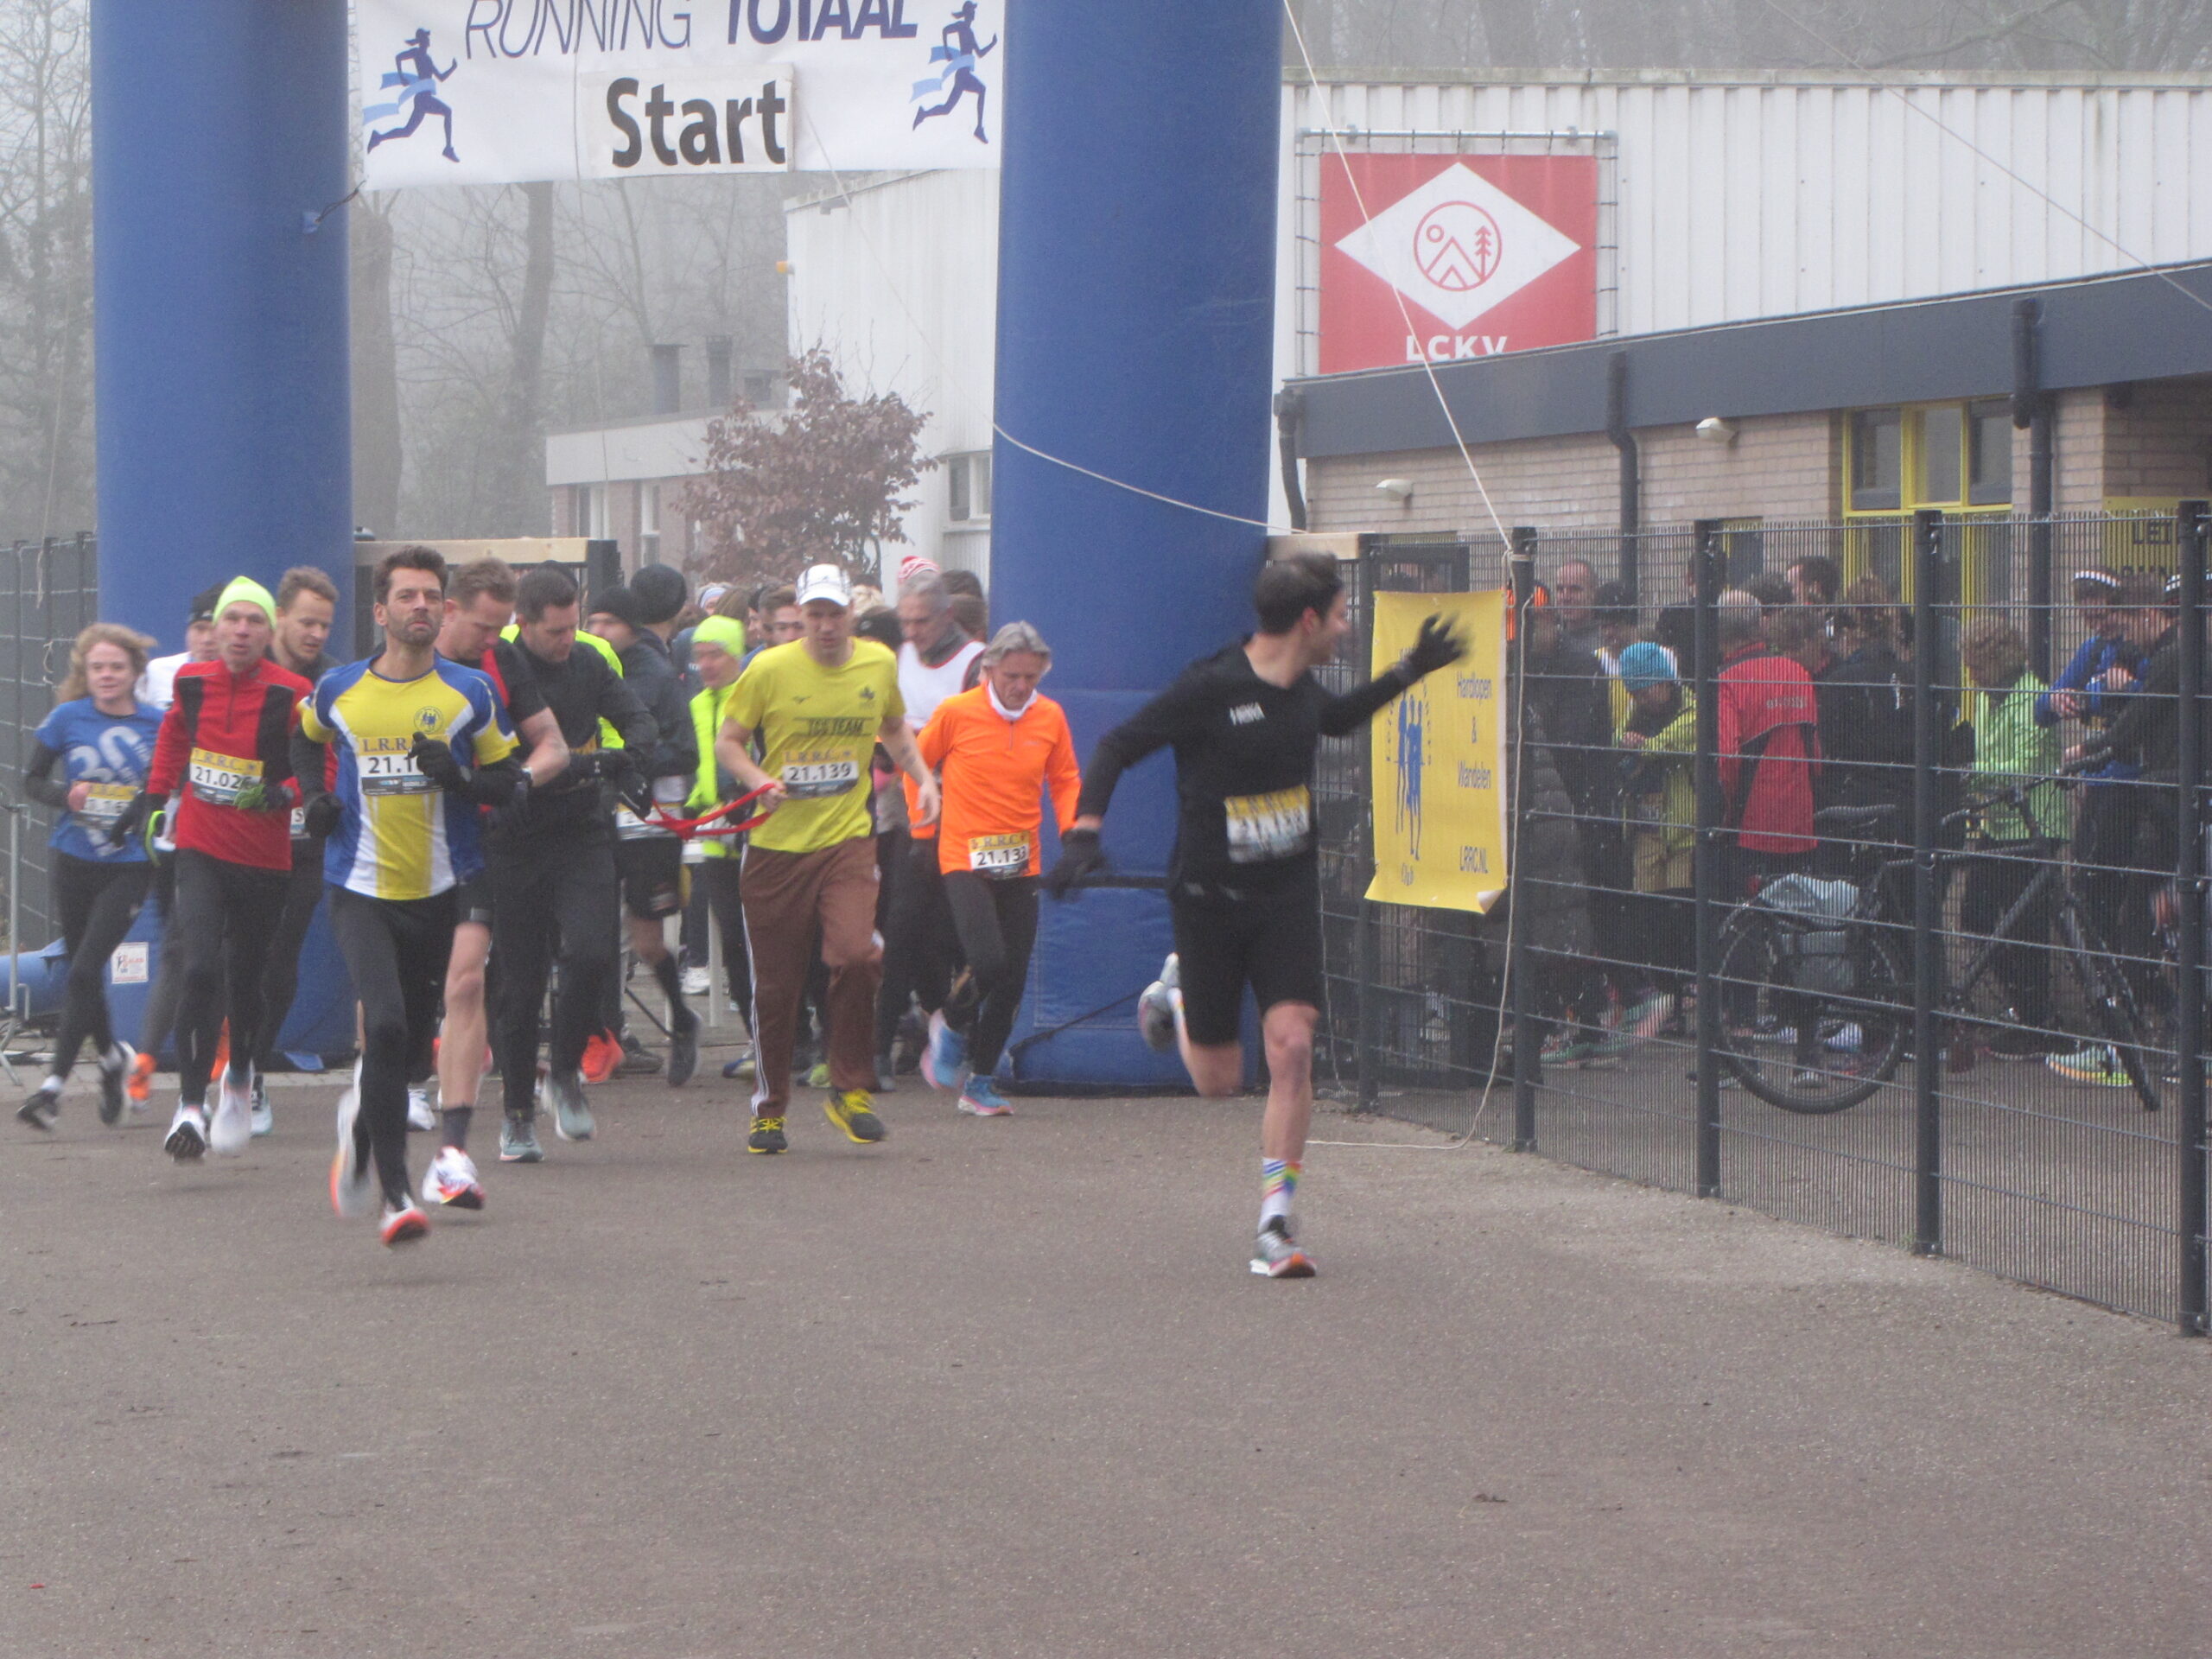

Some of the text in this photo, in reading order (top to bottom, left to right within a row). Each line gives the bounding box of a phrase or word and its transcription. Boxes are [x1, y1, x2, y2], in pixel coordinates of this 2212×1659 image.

[465, 0, 692, 60] RUNNING
[606, 76, 785, 168] Start
[1406, 334, 1508, 362] LCKV
[788, 763, 852, 781] 21.139
